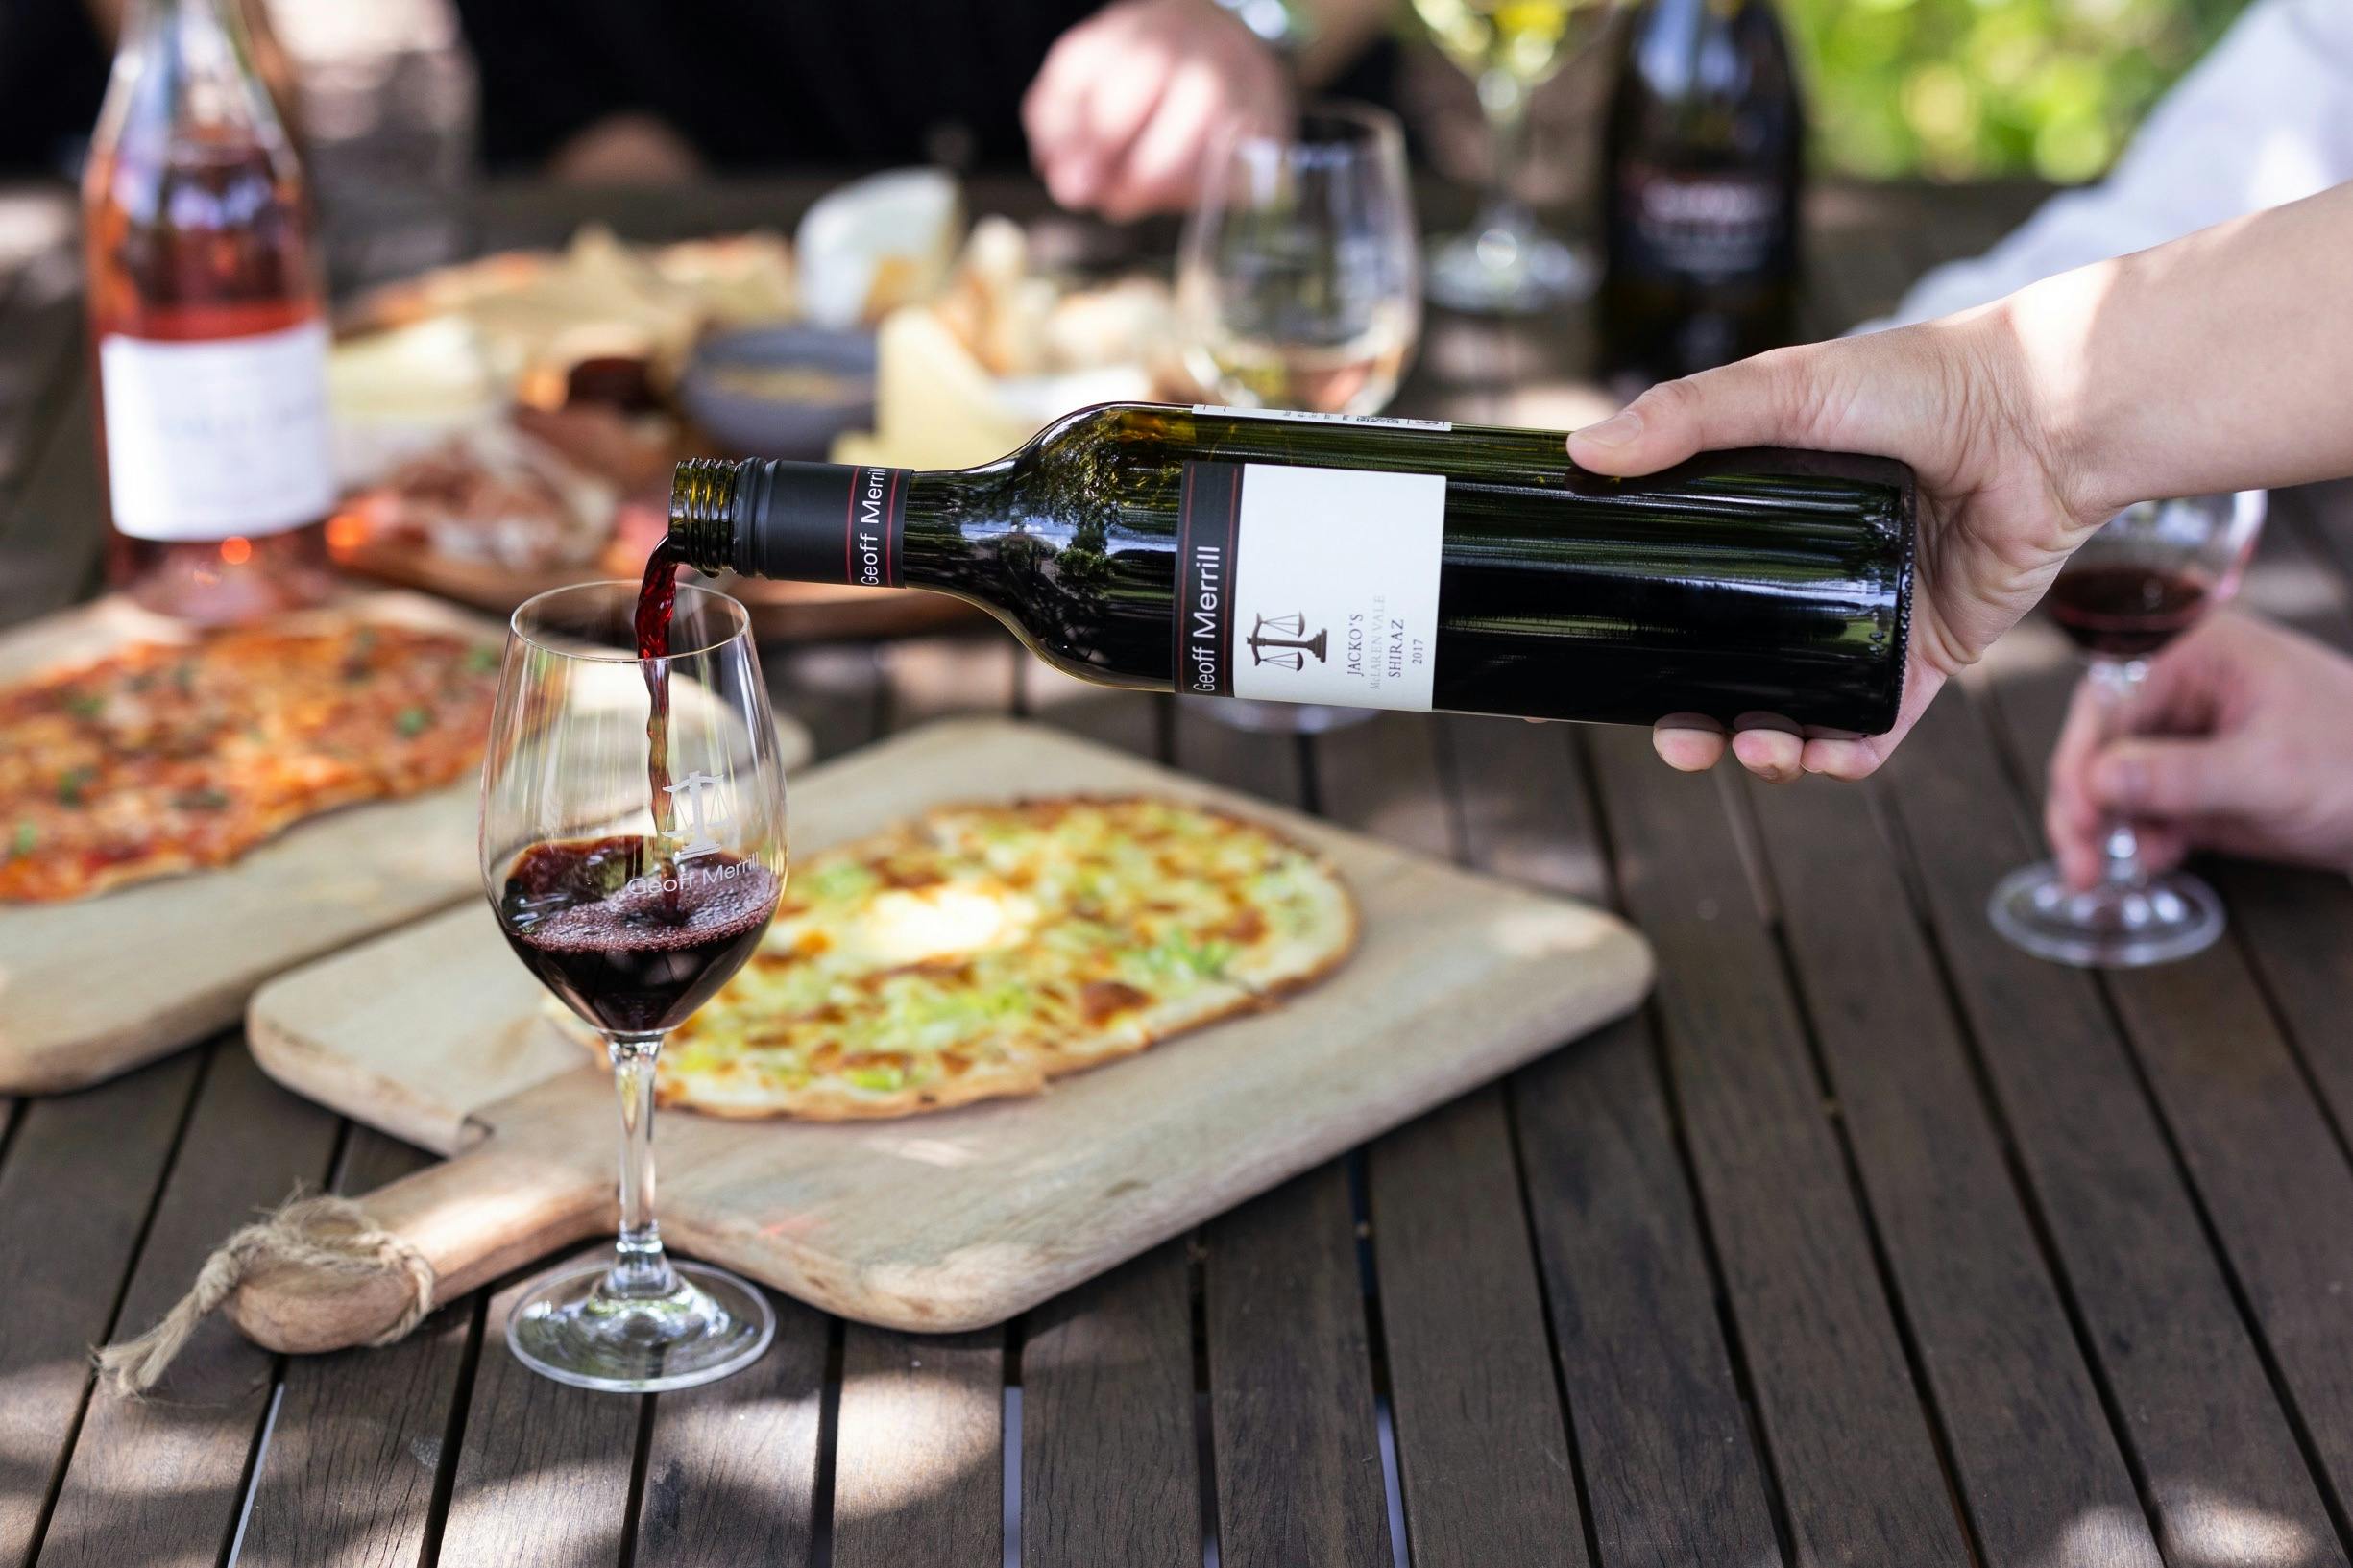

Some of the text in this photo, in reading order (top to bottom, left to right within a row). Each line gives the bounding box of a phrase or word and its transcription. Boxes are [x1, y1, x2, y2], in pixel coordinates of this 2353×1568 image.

[859, 532, 879, 586] Geoff
[1193, 545, 1221, 692] Geoff Merrill
[1347, 613, 1364, 677] JACKO'S
[1369, 594, 1386, 690] McLAREN VALE
[1388, 619, 1404, 678] SHIRAZ
[1412, 639, 1423, 664] 2017
[626, 851, 760, 895] Geoff Merrill
